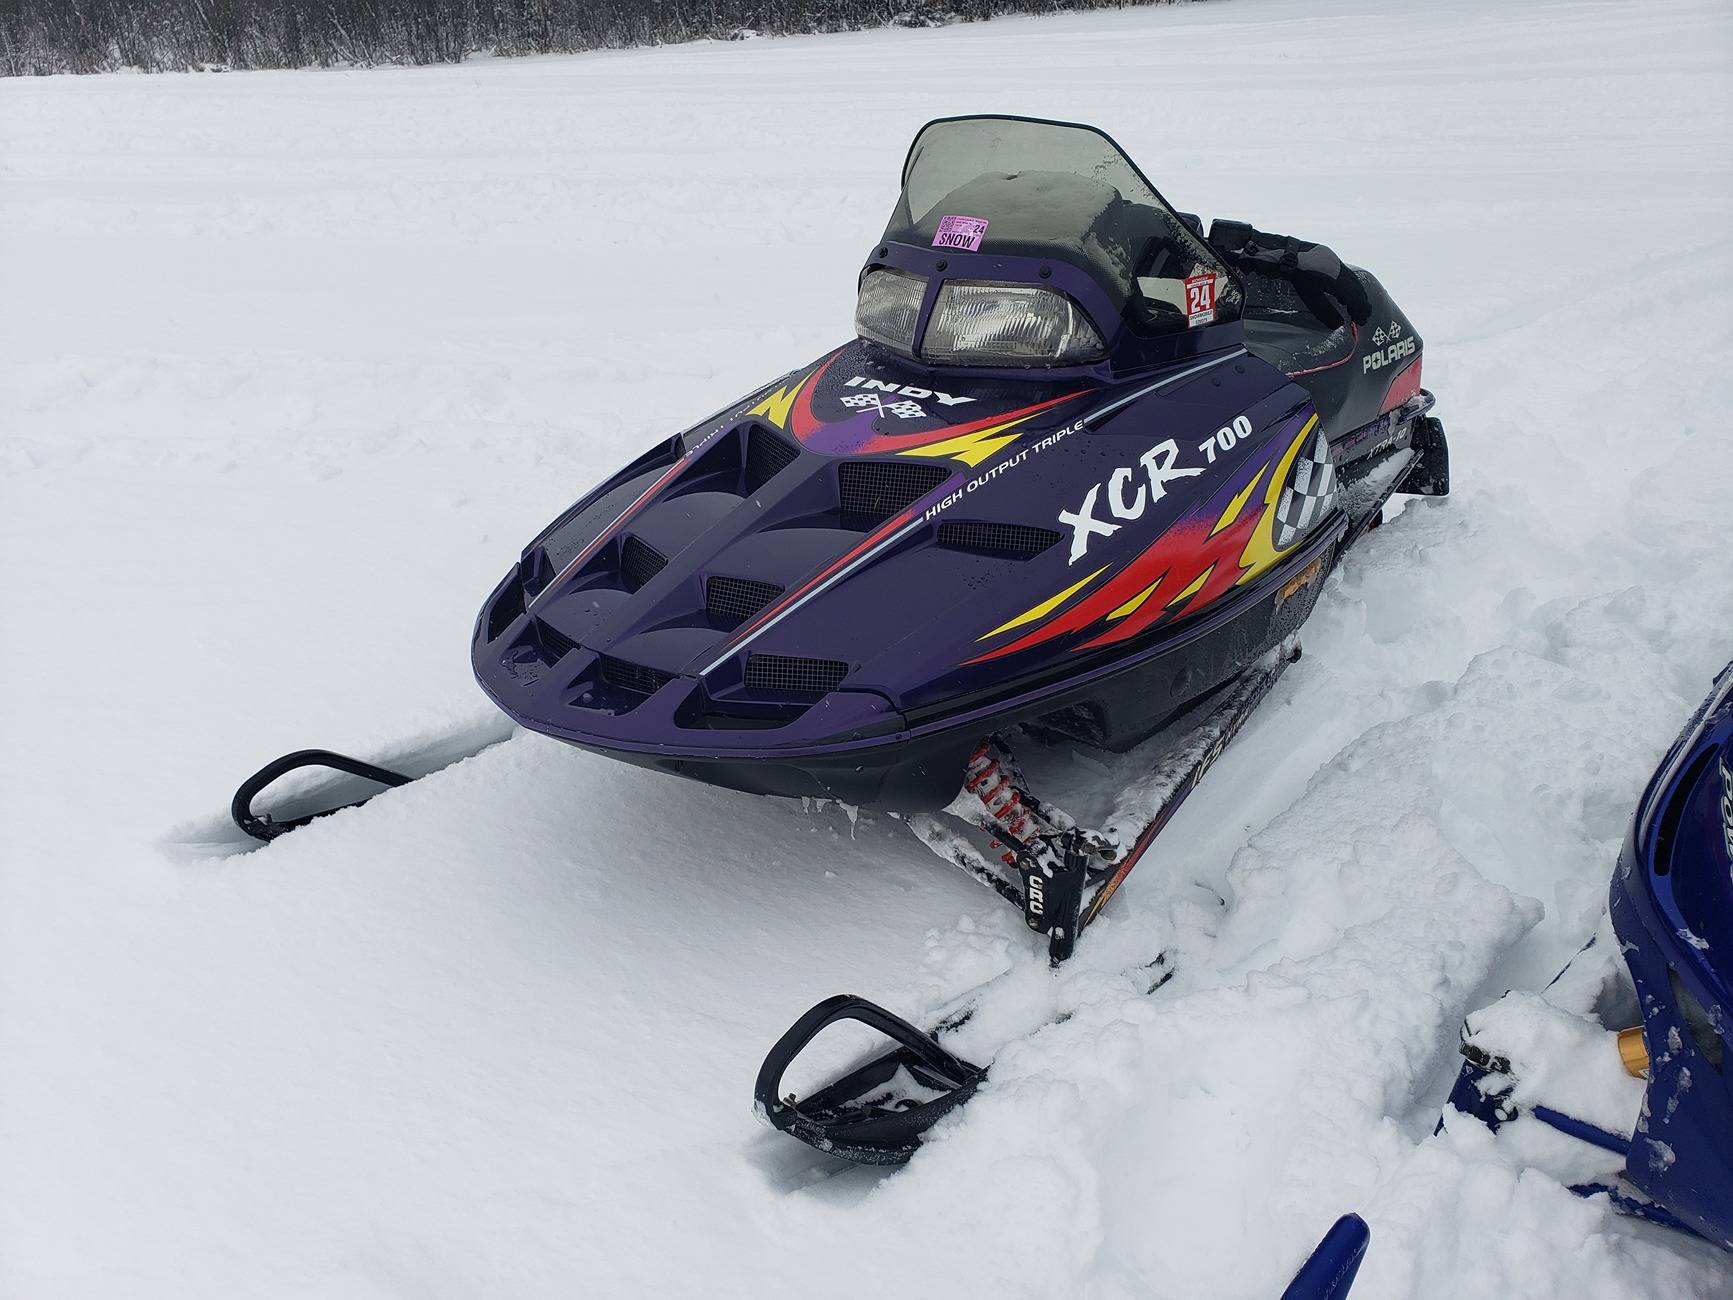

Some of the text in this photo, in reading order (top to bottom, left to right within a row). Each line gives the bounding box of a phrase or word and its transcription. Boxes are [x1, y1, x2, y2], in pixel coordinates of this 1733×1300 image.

[938, 232, 976, 248] SNOW
[973, 224, 985, 235] 24
[1190, 284, 1211, 313] 24
[1363, 336, 1415, 374] POLARIS
[844, 376, 977, 406] INDY
[925, 419, 1085, 521] HIGH OUTPUT TRIPLE
[1058, 415, 1253, 567] XCR 700
[1719, 755, 1733, 884] POW
[1028, 874, 1044, 916] CRC
